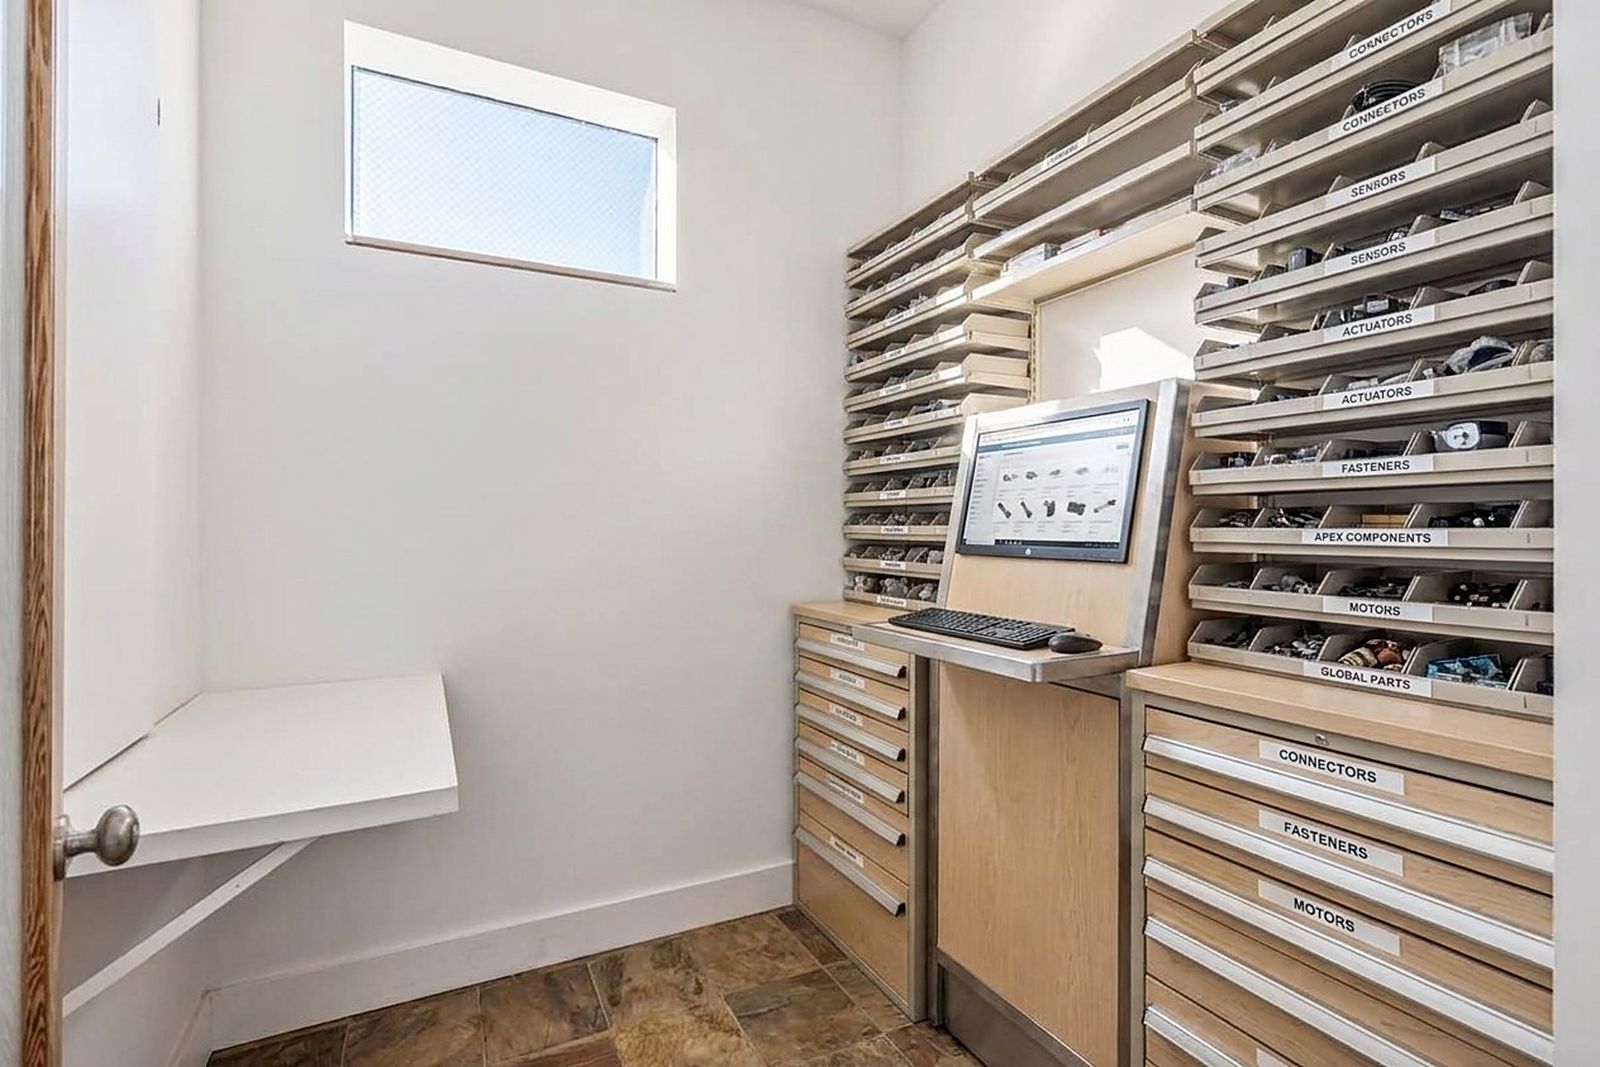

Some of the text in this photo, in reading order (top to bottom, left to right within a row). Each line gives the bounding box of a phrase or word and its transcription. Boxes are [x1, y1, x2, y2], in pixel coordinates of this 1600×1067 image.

[1350, 242, 1406, 266] SENSORS
[1342, 314, 1412, 337] ACTUATORS
[1341, 386, 1412, 404] ACTUATORS
[1341, 460, 1410, 473] FASTENERS
[1314, 533, 1431, 543] APEX COMPONENTS
[1349, 602, 1400, 616] MOTORS
[1321, 667, 1411, 690] GLOBAL PARTS
[1279, 749, 1377, 783] CONNECTORS
[1283, 821, 1368, 859] FASTENERS
[1293, 898, 1355, 933] MOTORS
